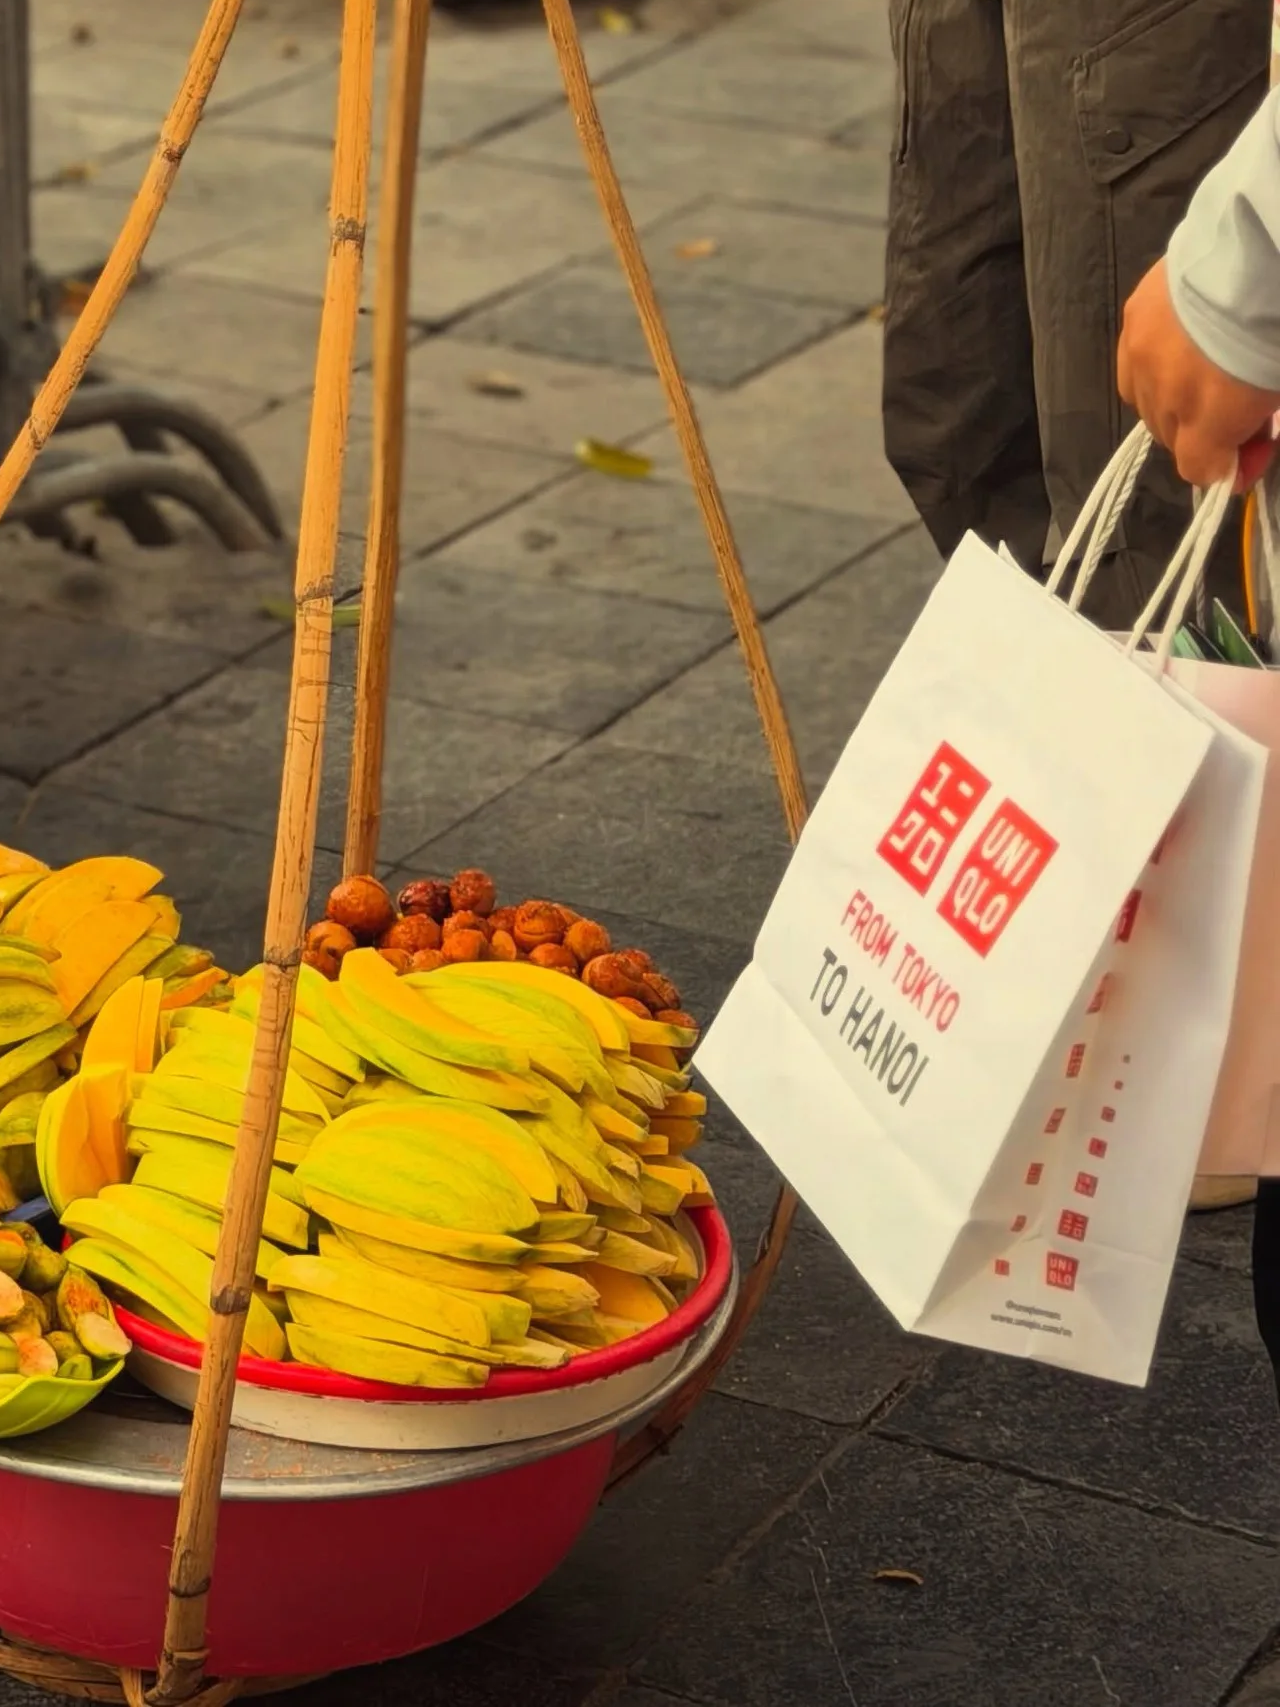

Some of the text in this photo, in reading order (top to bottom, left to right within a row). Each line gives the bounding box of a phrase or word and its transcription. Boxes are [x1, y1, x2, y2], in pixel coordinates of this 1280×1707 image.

[809, 946, 930, 1109] TO HANOI
[840, 889, 961, 1034] FROM TOKYO
